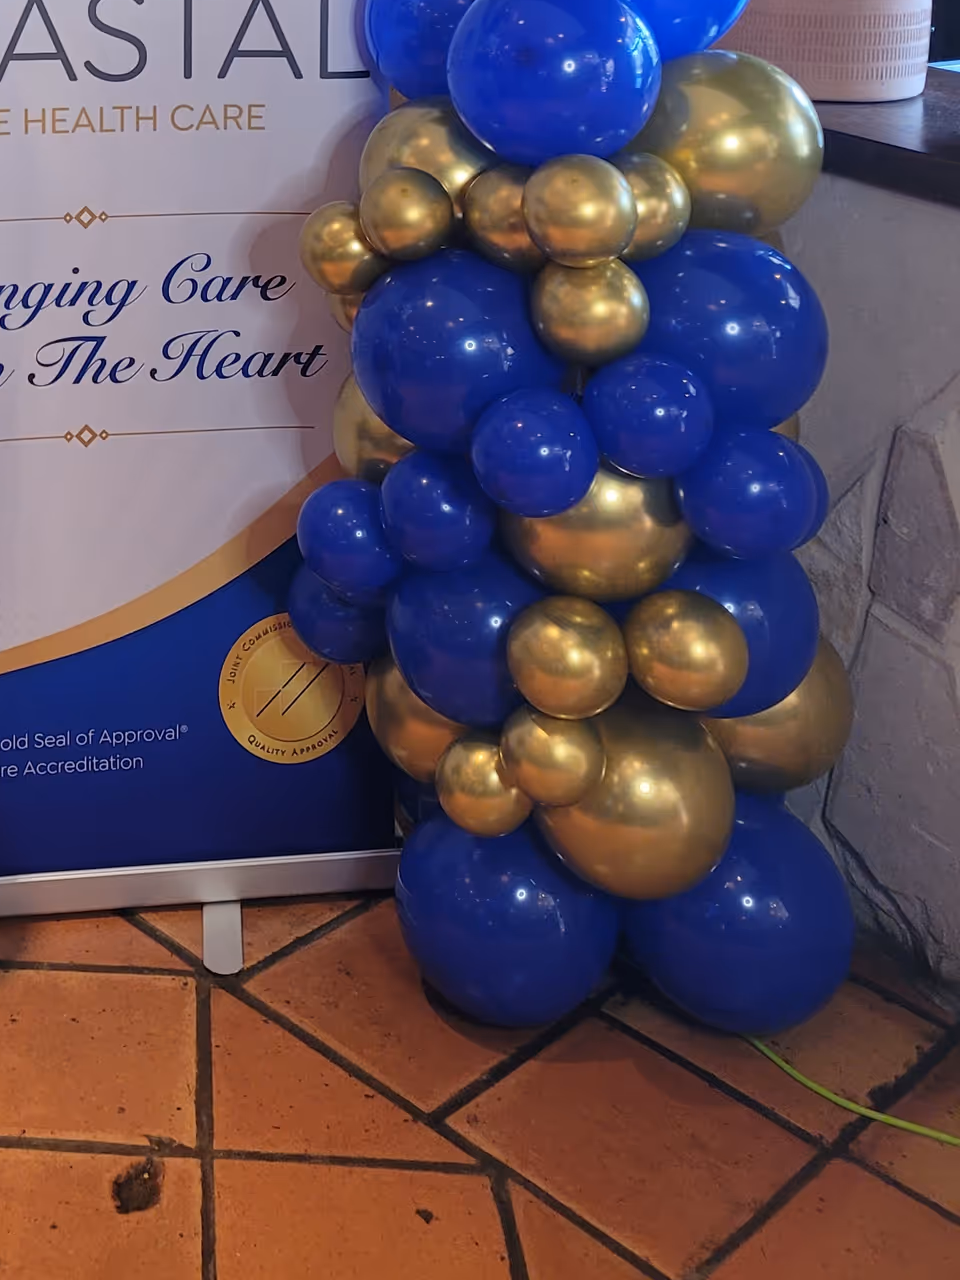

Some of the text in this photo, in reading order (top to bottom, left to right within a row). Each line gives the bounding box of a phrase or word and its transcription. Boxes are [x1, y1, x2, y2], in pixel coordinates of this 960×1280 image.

[24, 104, 159, 136] HEALTH
[170, 103, 267, 132] CARE
[161, 251, 297, 306] Care
[27, 335, 145, 389] The
[149, 329, 330, 385] Heart
[226, 620, 292, 684] JOINT COMMISSIO
[34, 730, 70, 748] Seal
[75, 729, 96, 746] of
[247, 728, 339, 756] QUALITY APPROVAL
[23, 754, 144, 776] Accreditation
